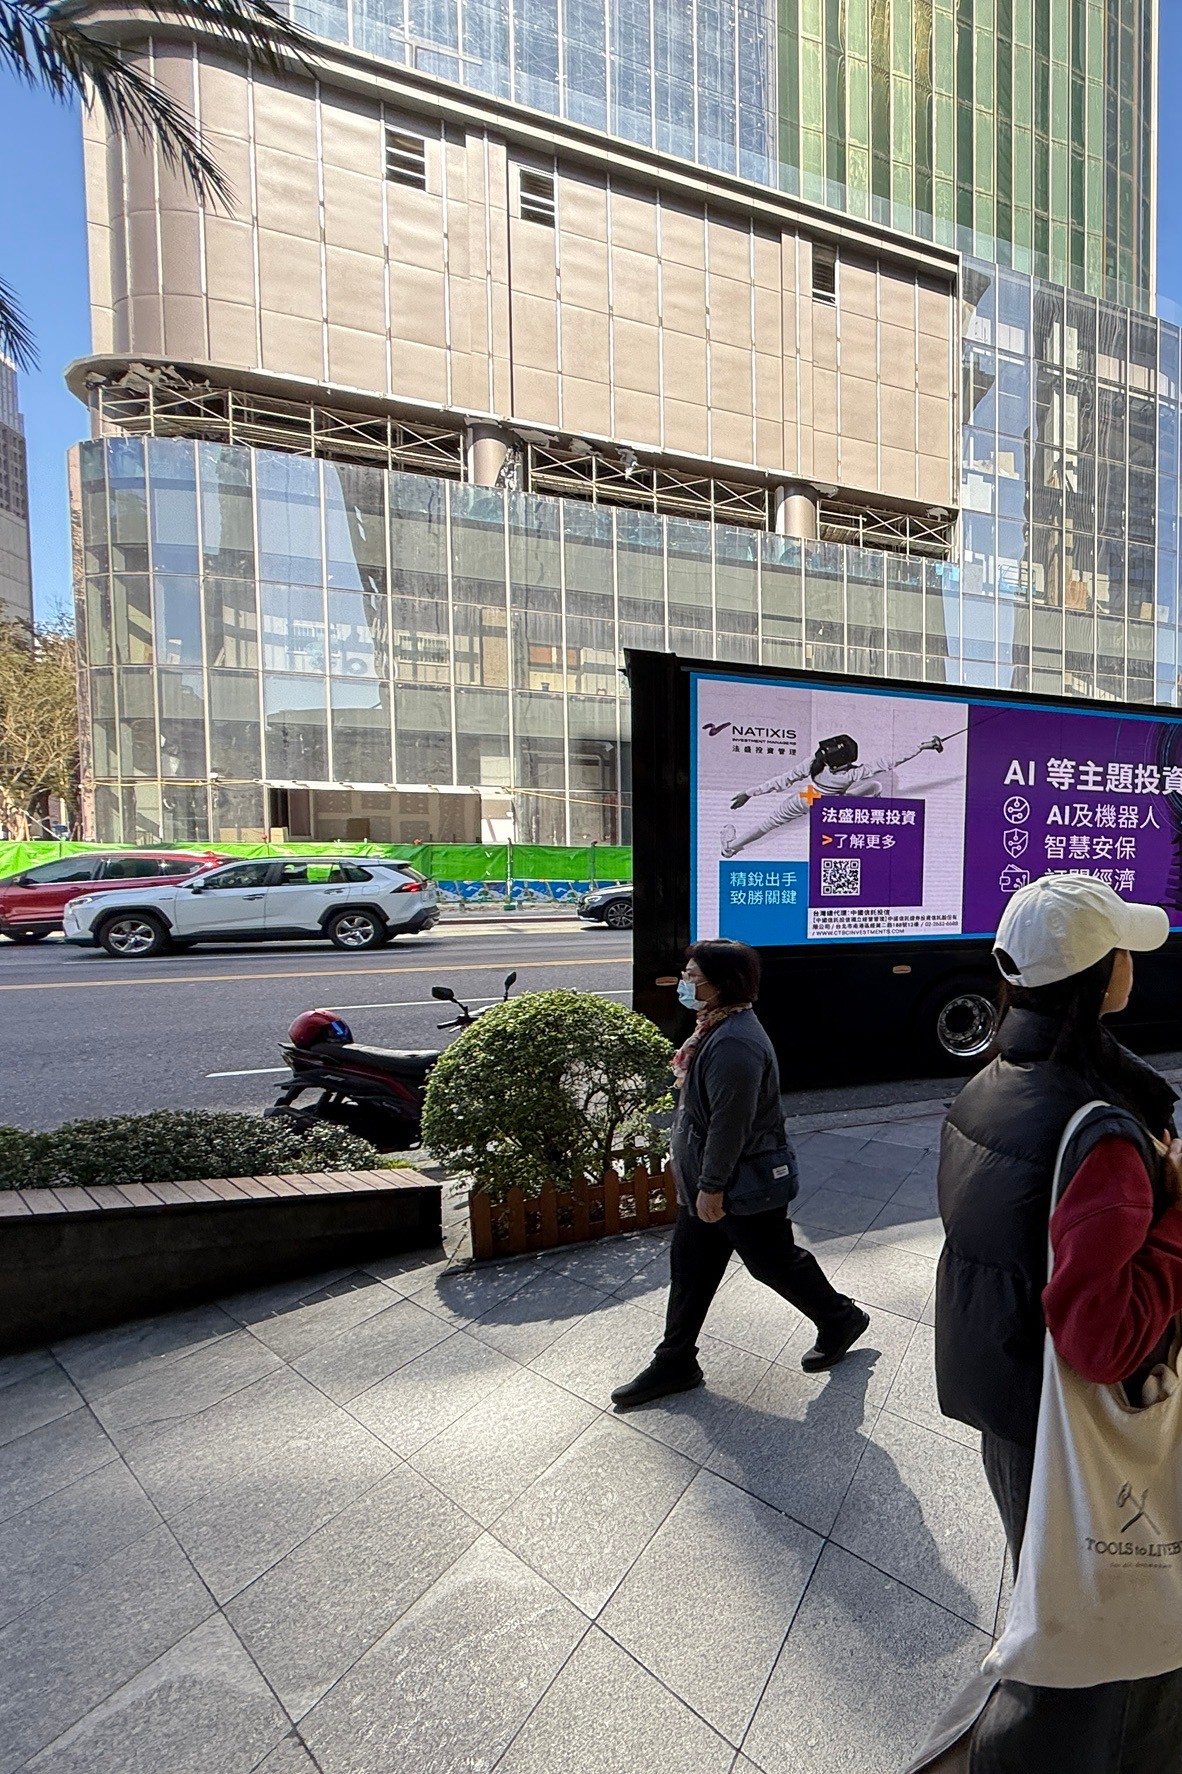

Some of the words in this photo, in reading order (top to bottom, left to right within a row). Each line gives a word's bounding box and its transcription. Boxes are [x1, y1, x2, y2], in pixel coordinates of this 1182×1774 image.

[732, 726, 797, 739] NATIXIS
[1003, 760, 1036, 786] AI
[821, 807, 916, 826] 法盛股票投資
[1046, 803, 1160, 829] AI及機器人
[1044, 834, 1136, 860] 智慧安保
[730, 871, 797, 887] 精銳出手
[1044, 867, 1136, 892] 經濟
[730, 890, 797, 905] 致勝關鍵
[1085, 1537, 1133, 1556] TOOLS
[1135, 1545, 1147, 1555] to
